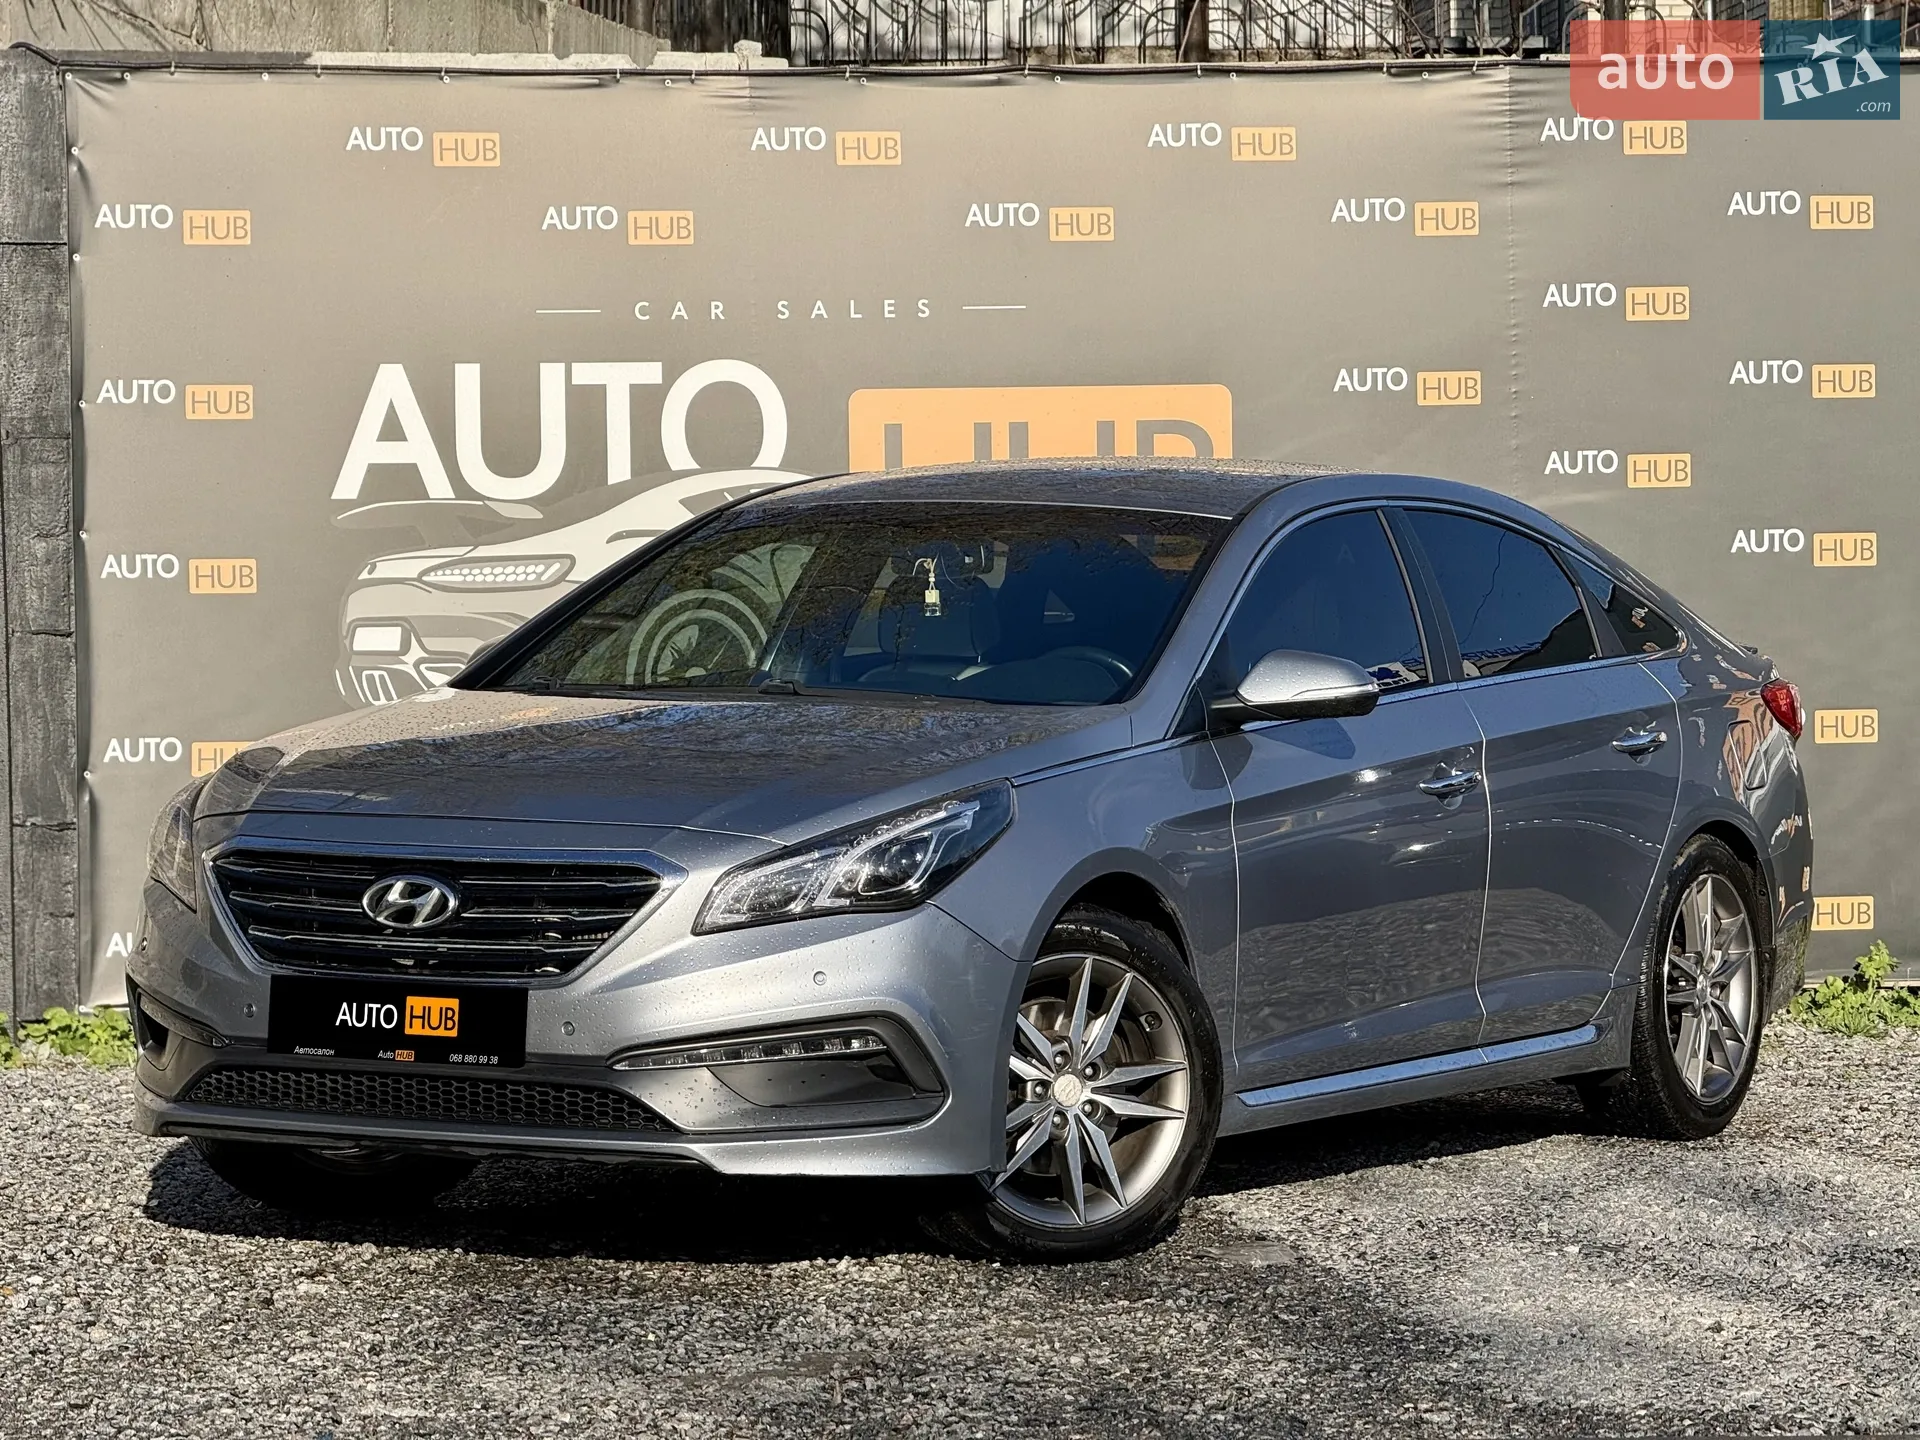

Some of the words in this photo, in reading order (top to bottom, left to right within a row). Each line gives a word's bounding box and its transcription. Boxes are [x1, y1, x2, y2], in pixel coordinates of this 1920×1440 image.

[345, 126, 424, 152] AUTO
[439, 138, 499, 162] HUB
[750, 126, 827, 151] AUTO
[841, 137, 898, 162] HUB
[1147, 122, 1222, 148] AUTO
[1237, 132, 1294, 158] HUB
[1540, 117, 1615, 142] AUTO
[1628, 126, 1685, 150] HUB
[94, 203, 174, 229] AUTO
[187, 215, 249, 241] HUB
[541, 205, 619, 230] AUTO
[632, 216, 692, 241] HUB
[964, 202, 1040, 227] AUTO
[1054, 212, 1112, 237] HUB
[1330, 197, 1406, 223] AUTO
[1419, 207, 1476, 232] HUB
[1727, 190, 1801, 216] AUTO
[1815, 201, 1871, 225] HUB
[634, 301, 726, 320] CAR
[776, 299, 931, 320] SALES
[1542, 282, 1617, 308] AUTO
[1630, 292, 1687, 316] HUB
[1333, 366, 1408, 392] AUTO
[1422, 376, 1479, 401] HUB
[1729, 359, 1804, 385] AUTO
[1817, 369, 1873, 394] HUB
[95, 379, 176, 404] AUTO
[190, 390, 251, 415] HUB
[330, 358, 788, 500] AUTO
[1544, 449, 1619, 475] AUTO
[1632, 459, 1689, 483] HUB
[1730, 528, 1805, 553] AUTO
[1818, 538, 1874, 562] HUB
[100, 553, 180, 579] AUTO
[194, 564, 255, 589] HUB
[1820, 715, 1875, 738] HUB
[103, 737, 183, 763] AUTO
[1815, 901, 1871, 925] HUB
[335, 1001, 398, 1029] AUTO
[408, 1005, 457, 1031] HUB
[293, 1045, 335, 1056] Автосалон
[377, 1049, 394, 1059] Auto
[396, 1050, 414, 1060] HUB
[449, 1053, 463, 1063] 068
[463, 1054, 478, 1064] 880
[478, 1055, 488, 1064] 99
[488, 1056, 499, 1065] 38
